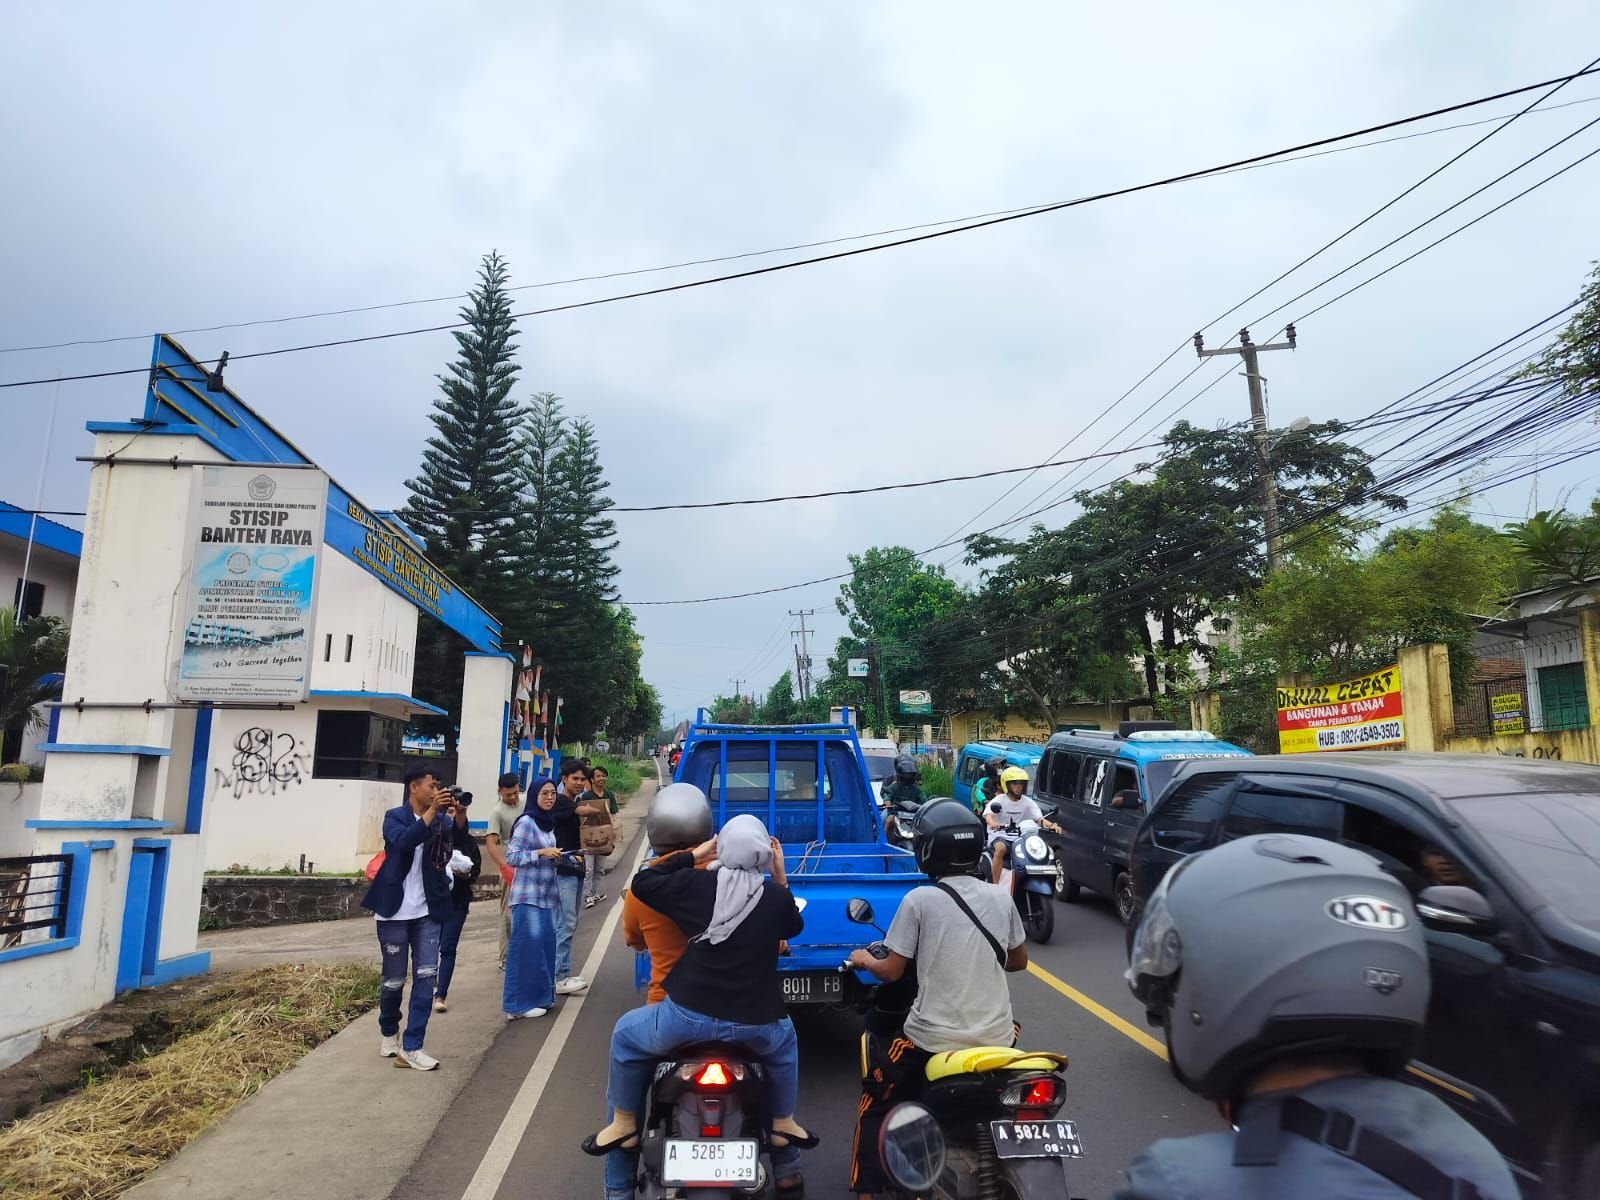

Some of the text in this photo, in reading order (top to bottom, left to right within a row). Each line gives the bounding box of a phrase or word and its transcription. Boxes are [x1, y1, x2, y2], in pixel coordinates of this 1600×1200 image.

[229, 509, 289, 527] STISIP
[348, 501, 374, 531] SEKOLAH
[201, 526, 313, 546] BANTEN RAYA
[366, 531, 392, 567] STISIP
[394, 554, 422, 591] BANTEN
[424, 579, 439, 602] RAYA
[214, 579, 256, 588] PROGRAM
[1337, 671, 1393, 701] CEPAT
[1286, 704, 1339, 721] BANGUNAN
[1341, 704, 1349, 714] &
[1308, 714, 1363, 728] TANPA PERANTARA
[1318, 732, 1335, 747] HUB
[953, 832, 975, 840] YAMAHA
[1329, 901, 1399, 926] KYT
[783, 976, 840, 994] 8011 FB
[999, 1125, 1009, 1140] A
[669, 1144, 754, 1161] A 5285 JJ
